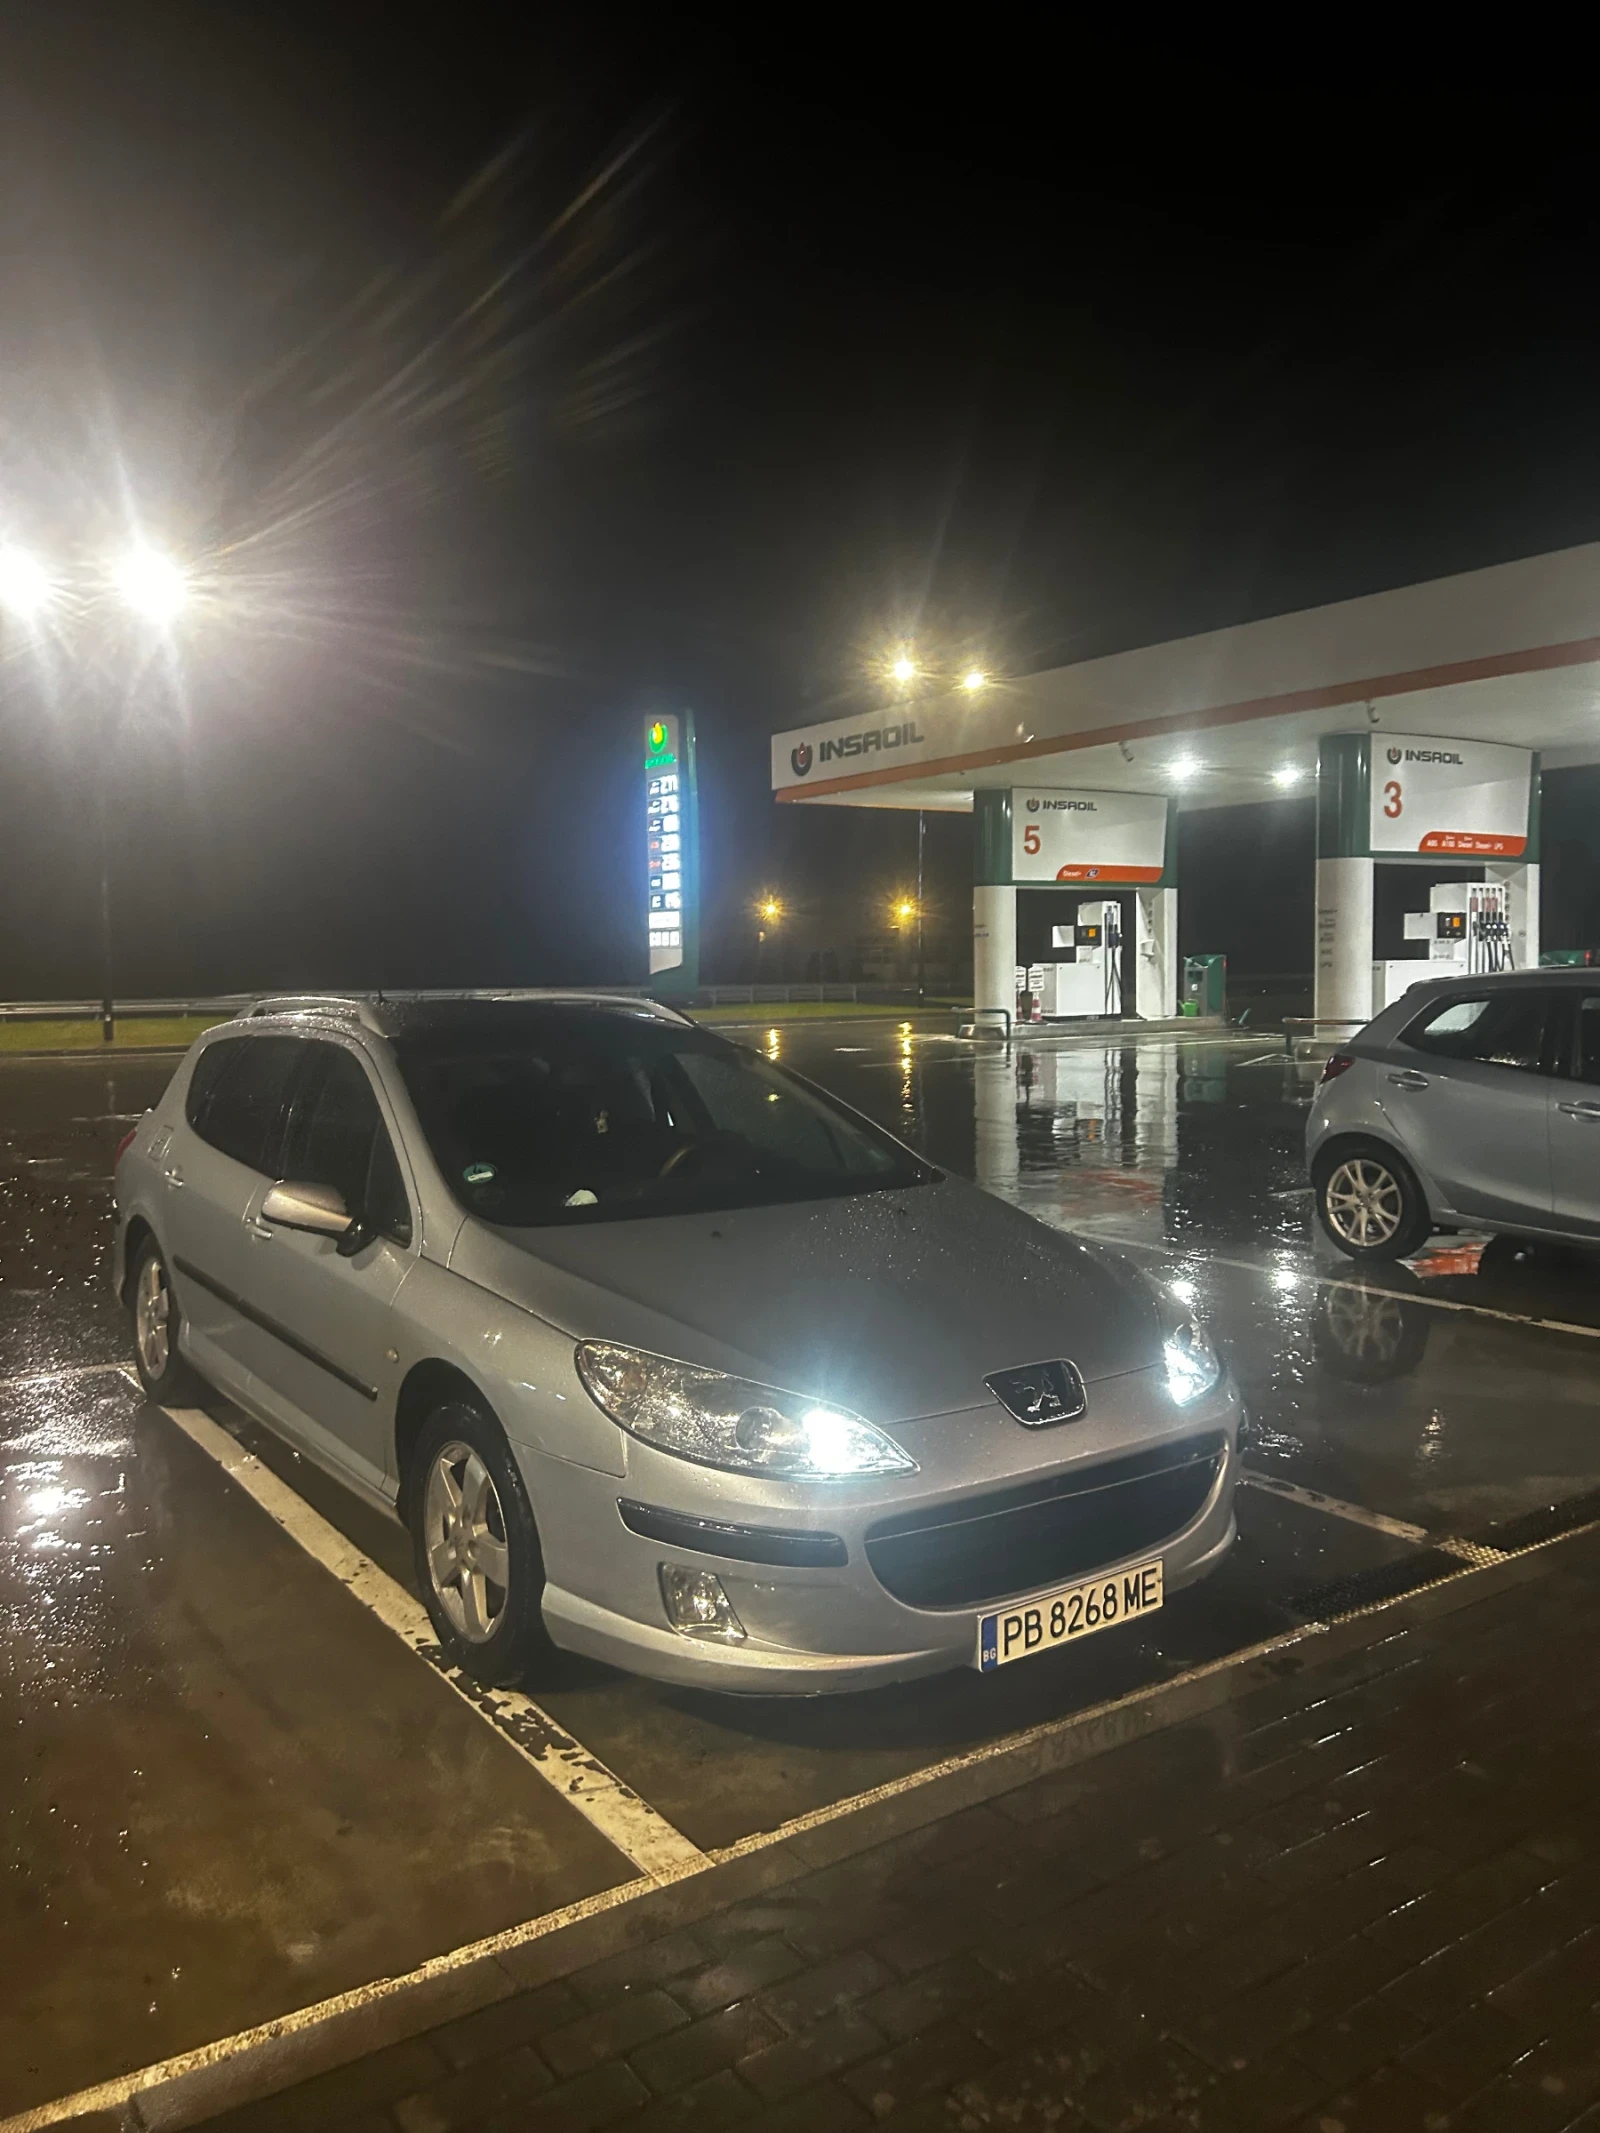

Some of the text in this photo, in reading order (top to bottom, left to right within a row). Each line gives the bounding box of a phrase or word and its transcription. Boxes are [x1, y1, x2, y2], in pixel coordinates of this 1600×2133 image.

[819, 722, 924, 762] INSAOIL
[1405, 749, 1463, 765] INSAOIL
[1043, 800, 1097, 812] INSAOIL
[1384, 781, 1403, 819] 3
[1024, 825, 1041, 855] 5
[983, 1567, 1157, 1662] BG PB 8268 ME
